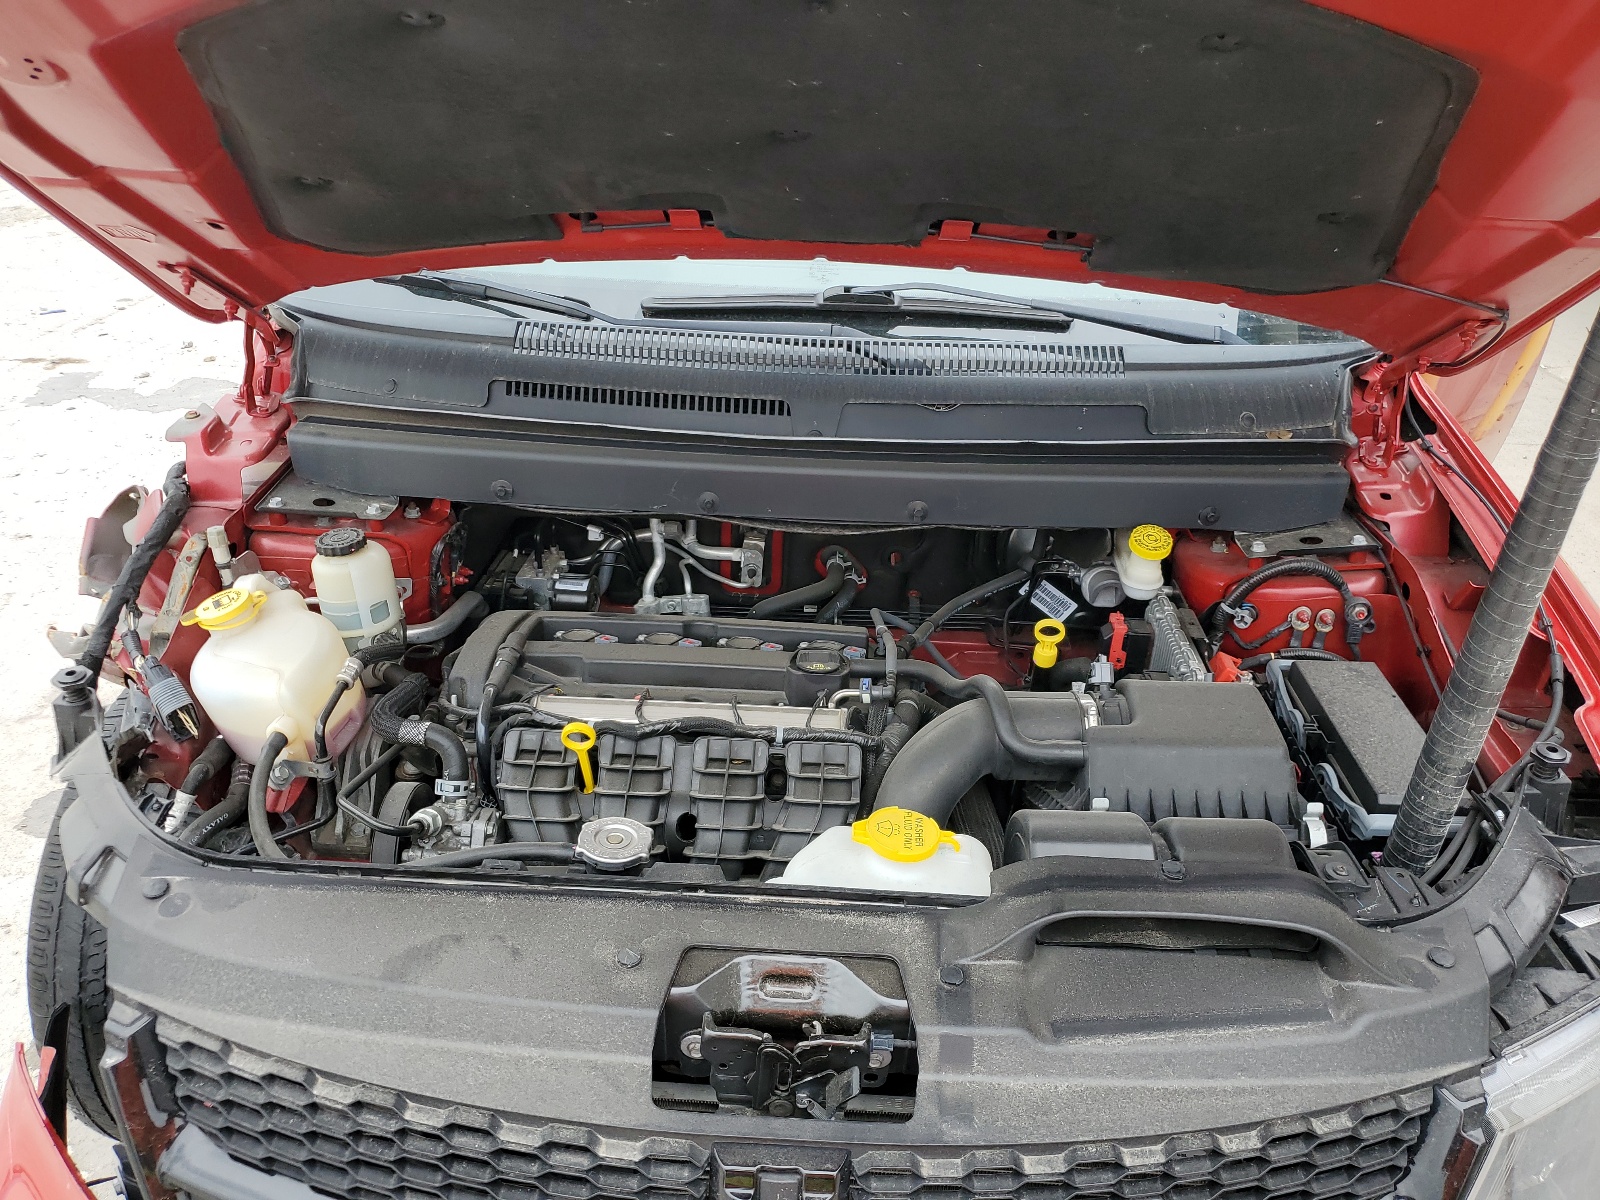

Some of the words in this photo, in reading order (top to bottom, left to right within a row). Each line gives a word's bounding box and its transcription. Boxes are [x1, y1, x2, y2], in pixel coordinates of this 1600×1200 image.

[202, 812, 229, 835] GALAXY
[904, 811, 912, 831] FLUID
[904, 832, 912, 850] ONLY
[915, 817, 924, 847] WASHER
